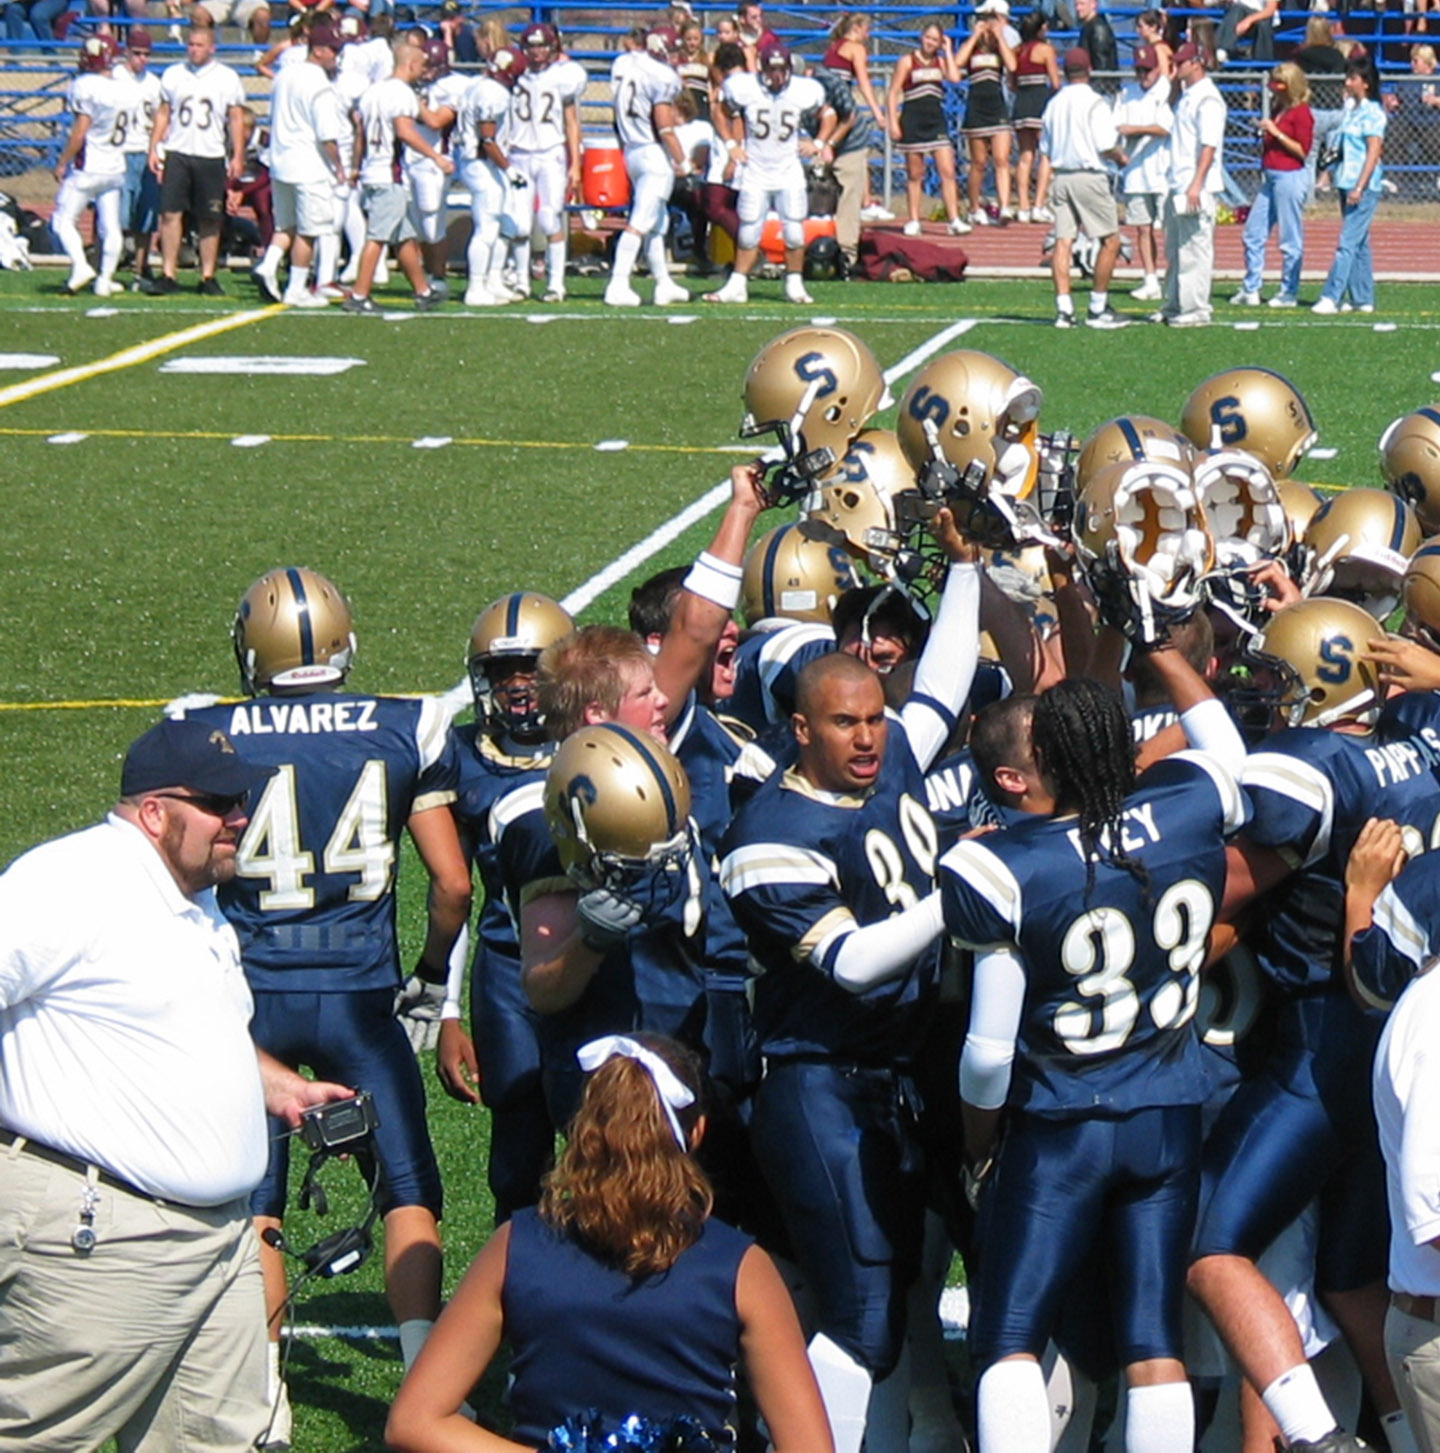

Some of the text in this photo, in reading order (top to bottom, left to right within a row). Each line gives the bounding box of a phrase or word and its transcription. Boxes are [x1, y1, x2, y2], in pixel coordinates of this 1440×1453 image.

[178, 95, 212, 130] 63
[754, 108, 795, 142] 55
[794, 352, 838, 398] S
[909, 386, 950, 428] S
[1210, 396, 1247, 443] S
[1316, 635, 1355, 684] S
[230, 701, 378, 736] ALVAREZ
[236, 759, 395, 912] 44
[1053, 879, 1214, 1056] 33
